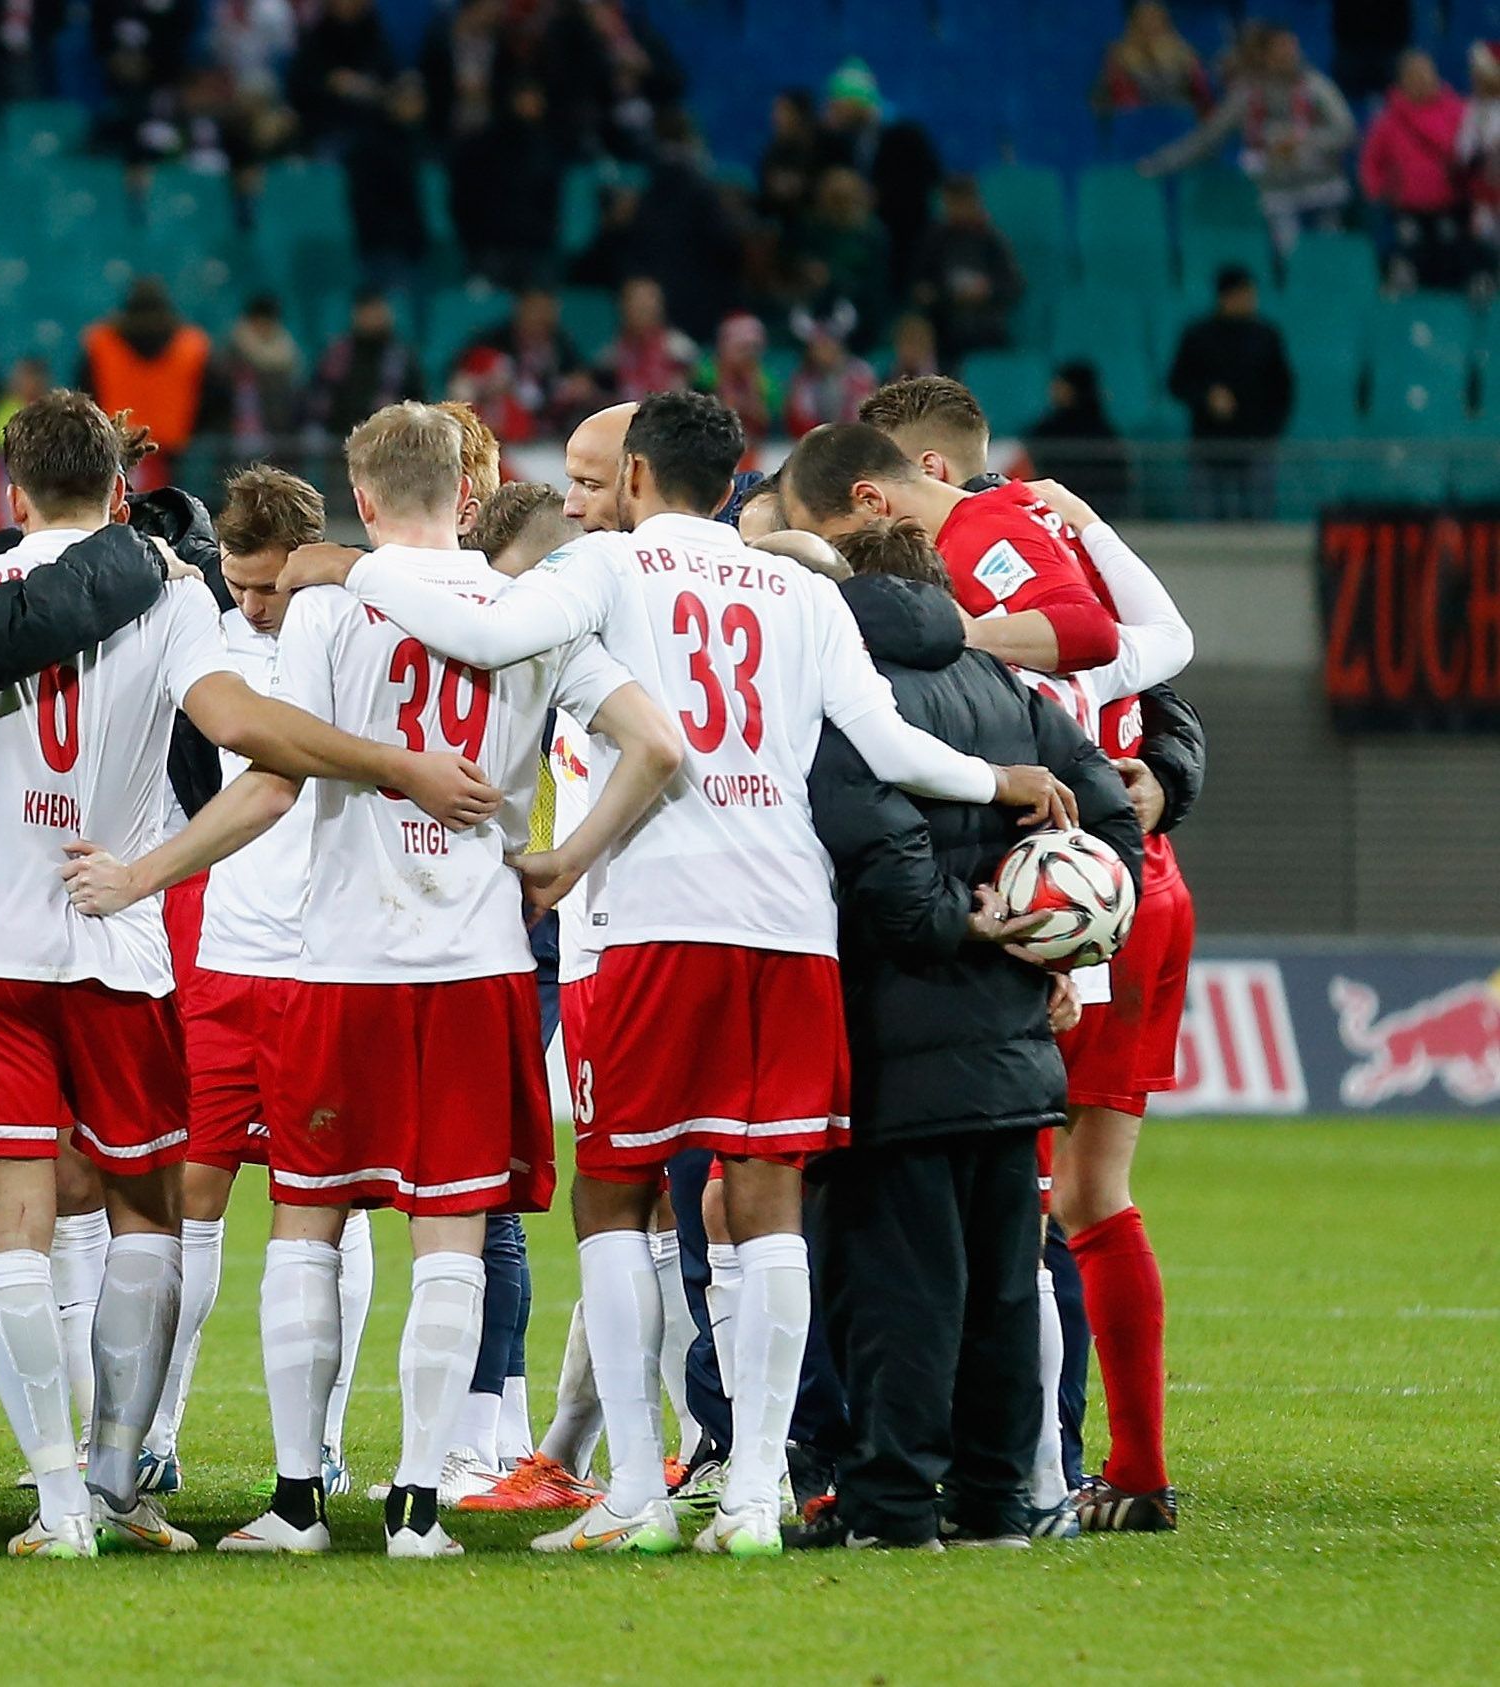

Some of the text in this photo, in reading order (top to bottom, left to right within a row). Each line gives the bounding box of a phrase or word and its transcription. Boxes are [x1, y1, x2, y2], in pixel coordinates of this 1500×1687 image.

[636, 547, 787, 596] RB LEIPZIG
[378, 637, 490, 800] 39
[673, 590, 762, 754] 33
[401, 821, 449, 855] TEIGL
